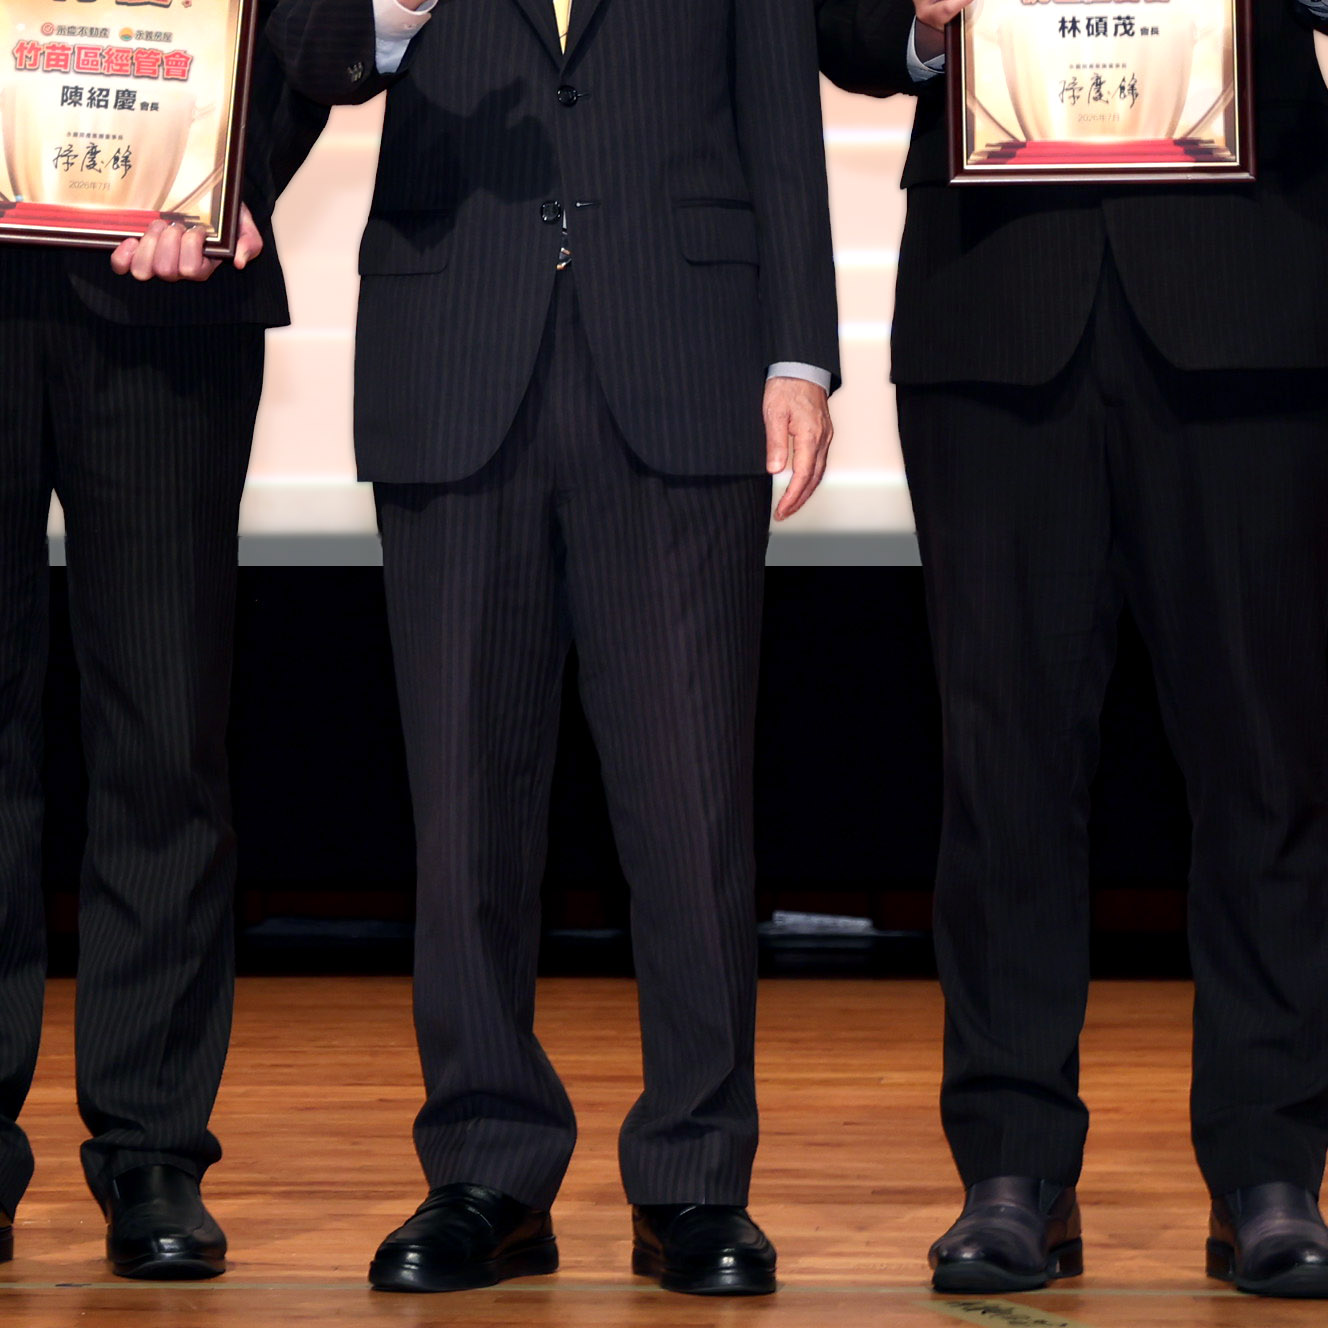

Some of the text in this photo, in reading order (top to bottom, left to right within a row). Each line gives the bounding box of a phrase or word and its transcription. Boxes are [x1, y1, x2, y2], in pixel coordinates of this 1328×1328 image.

[12, 40, 193, 81] 竹苗區經管會
